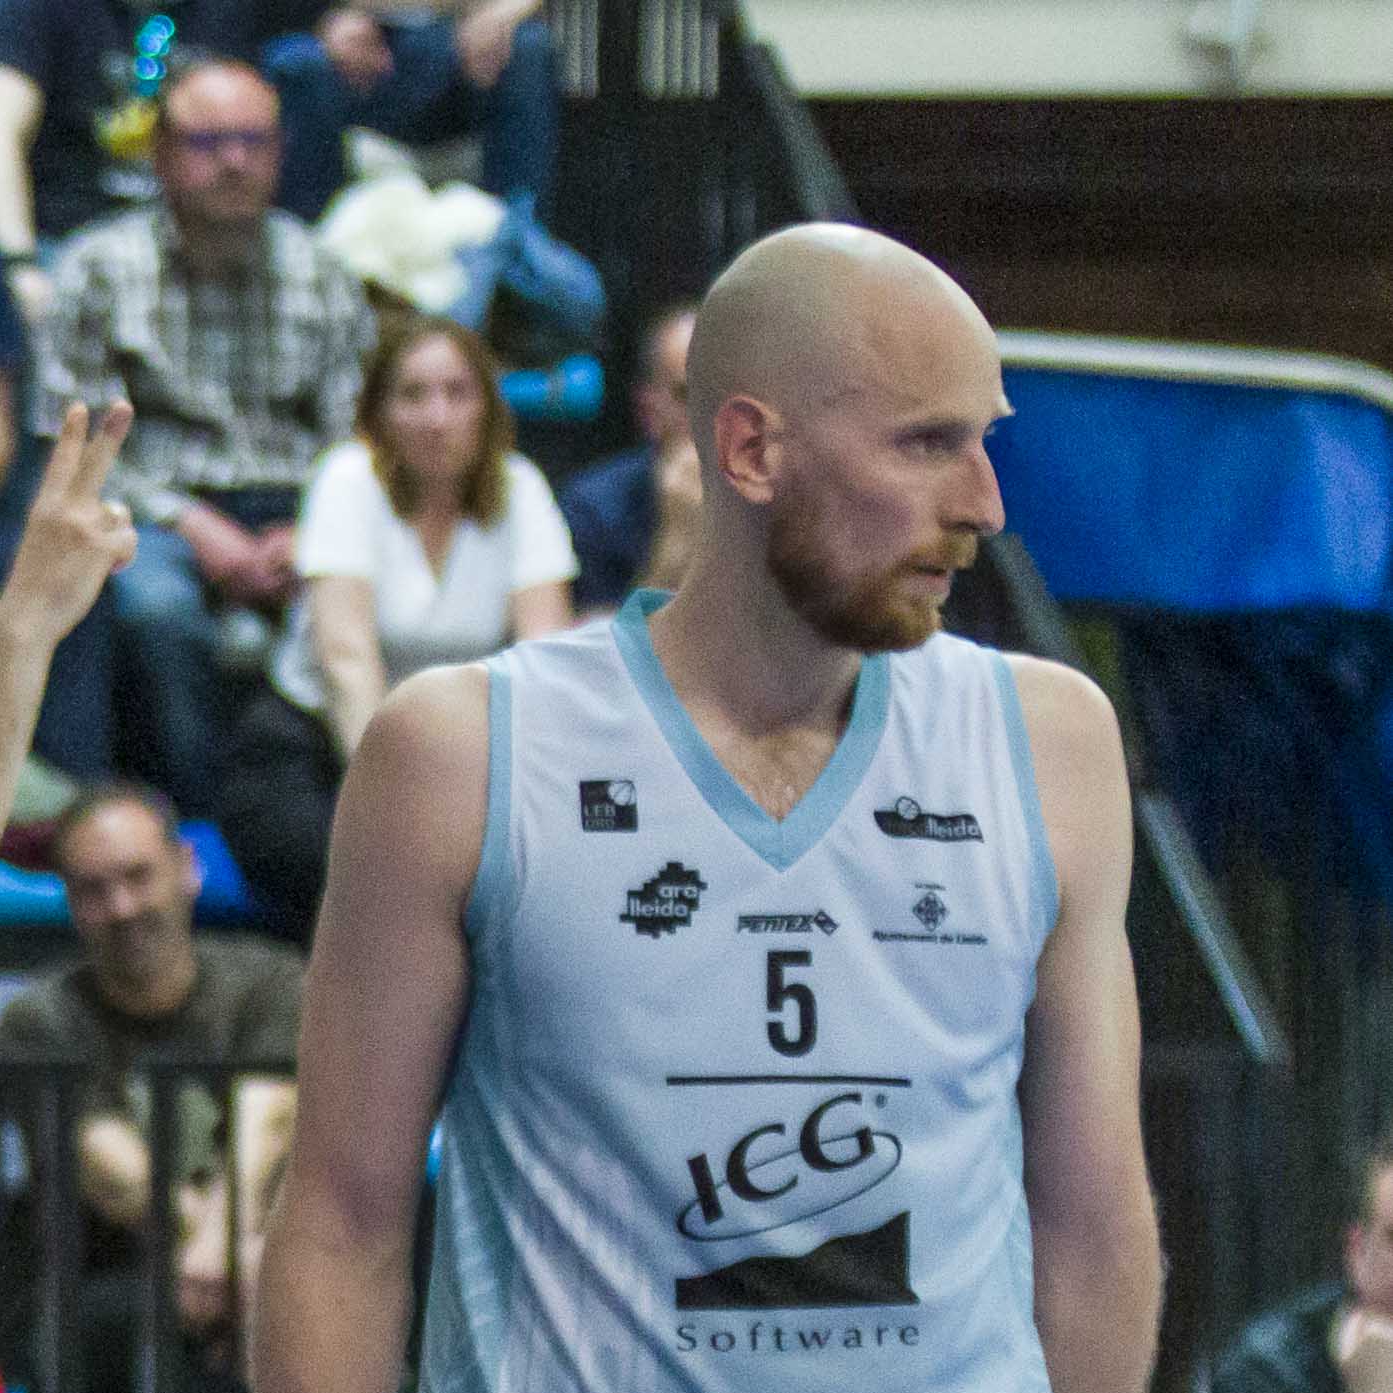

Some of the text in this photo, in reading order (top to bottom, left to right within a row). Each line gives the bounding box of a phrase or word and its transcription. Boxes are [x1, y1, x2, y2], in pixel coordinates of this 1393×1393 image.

[629, 897, 689, 917] lleida
[658, 884, 698, 899] ara
[766, 949, 818, 1058] 5
[687, 1092, 876, 1224] ICG
[675, 1320, 921, 1353] Software
